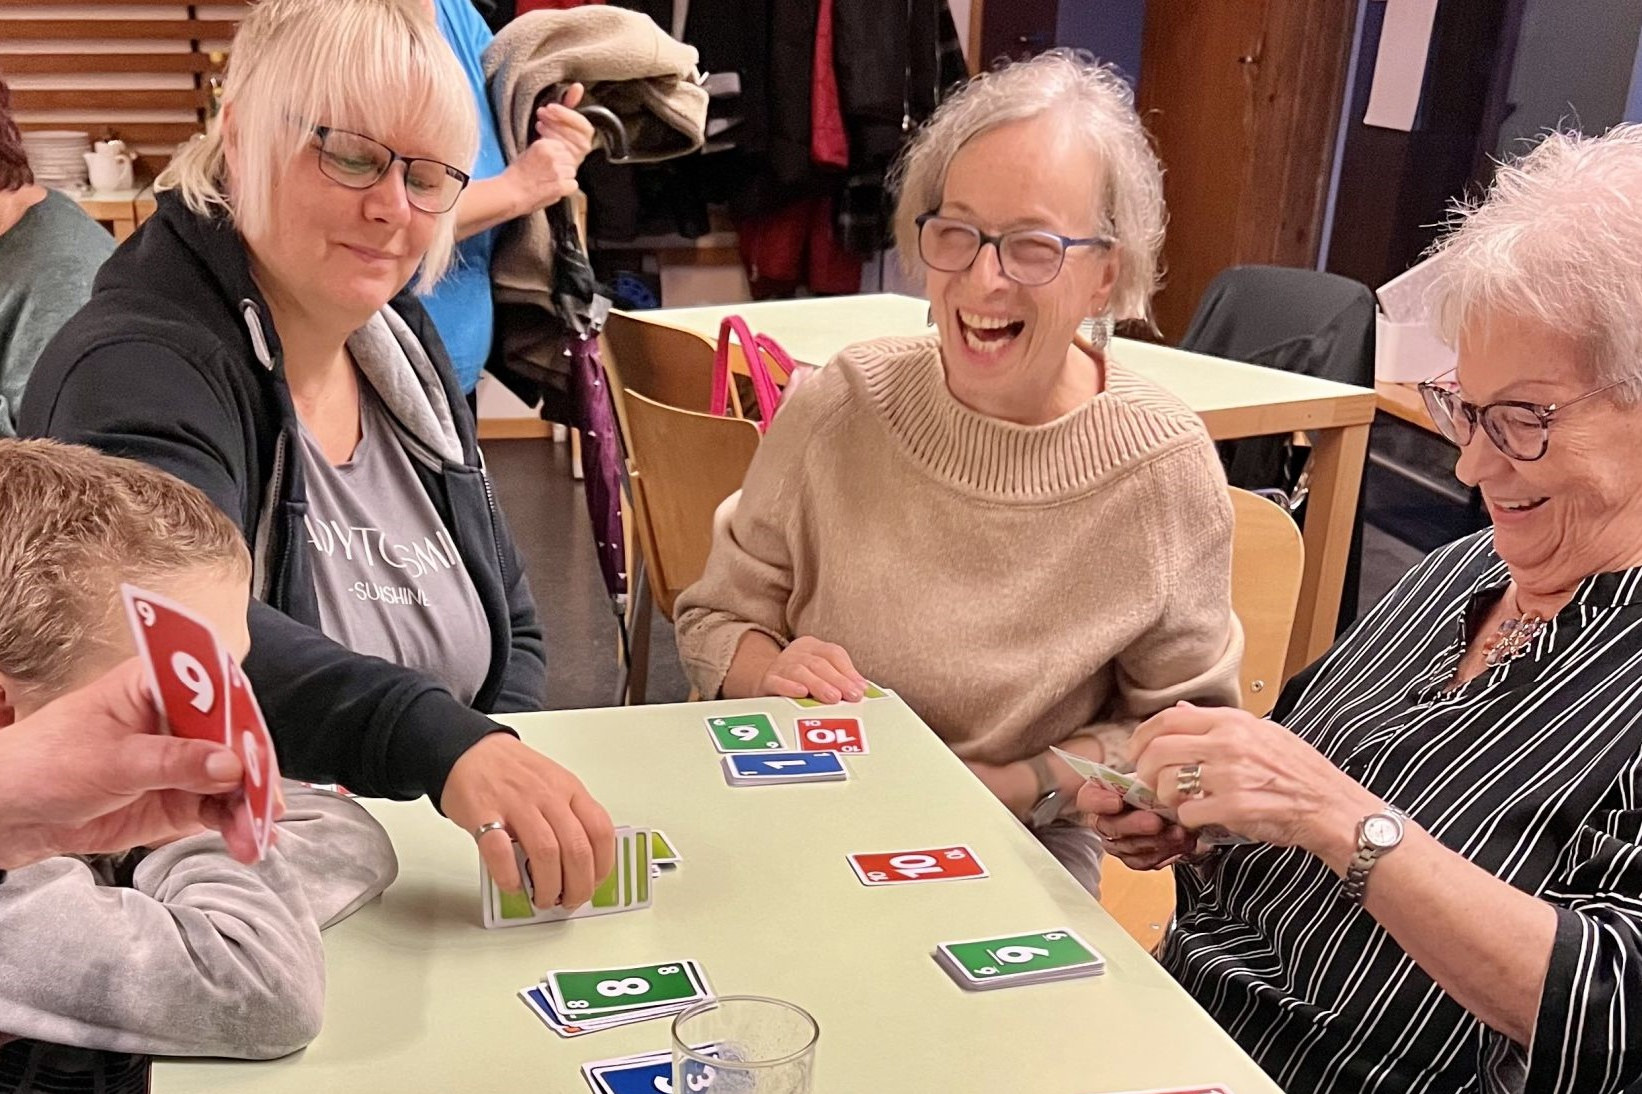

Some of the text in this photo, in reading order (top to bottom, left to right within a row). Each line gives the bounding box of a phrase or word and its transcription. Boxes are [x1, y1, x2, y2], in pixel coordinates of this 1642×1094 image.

[135, 600, 156, 627] 9
[171, 651, 215, 713] 9
[802, 719, 821, 727] 10
[806, 728, 857, 744] 10
[841, 744, 862, 752] 10
[763, 759, 808, 770] 1
[943, 849, 965, 860] 10
[888, 854, 944, 879] 10
[866, 871, 889, 882] 10
[657, 965, 679, 976] 8
[596, 977, 650, 997] 8
[566, 999, 590, 1009] 8
[686, 1064, 716, 1092] 3
